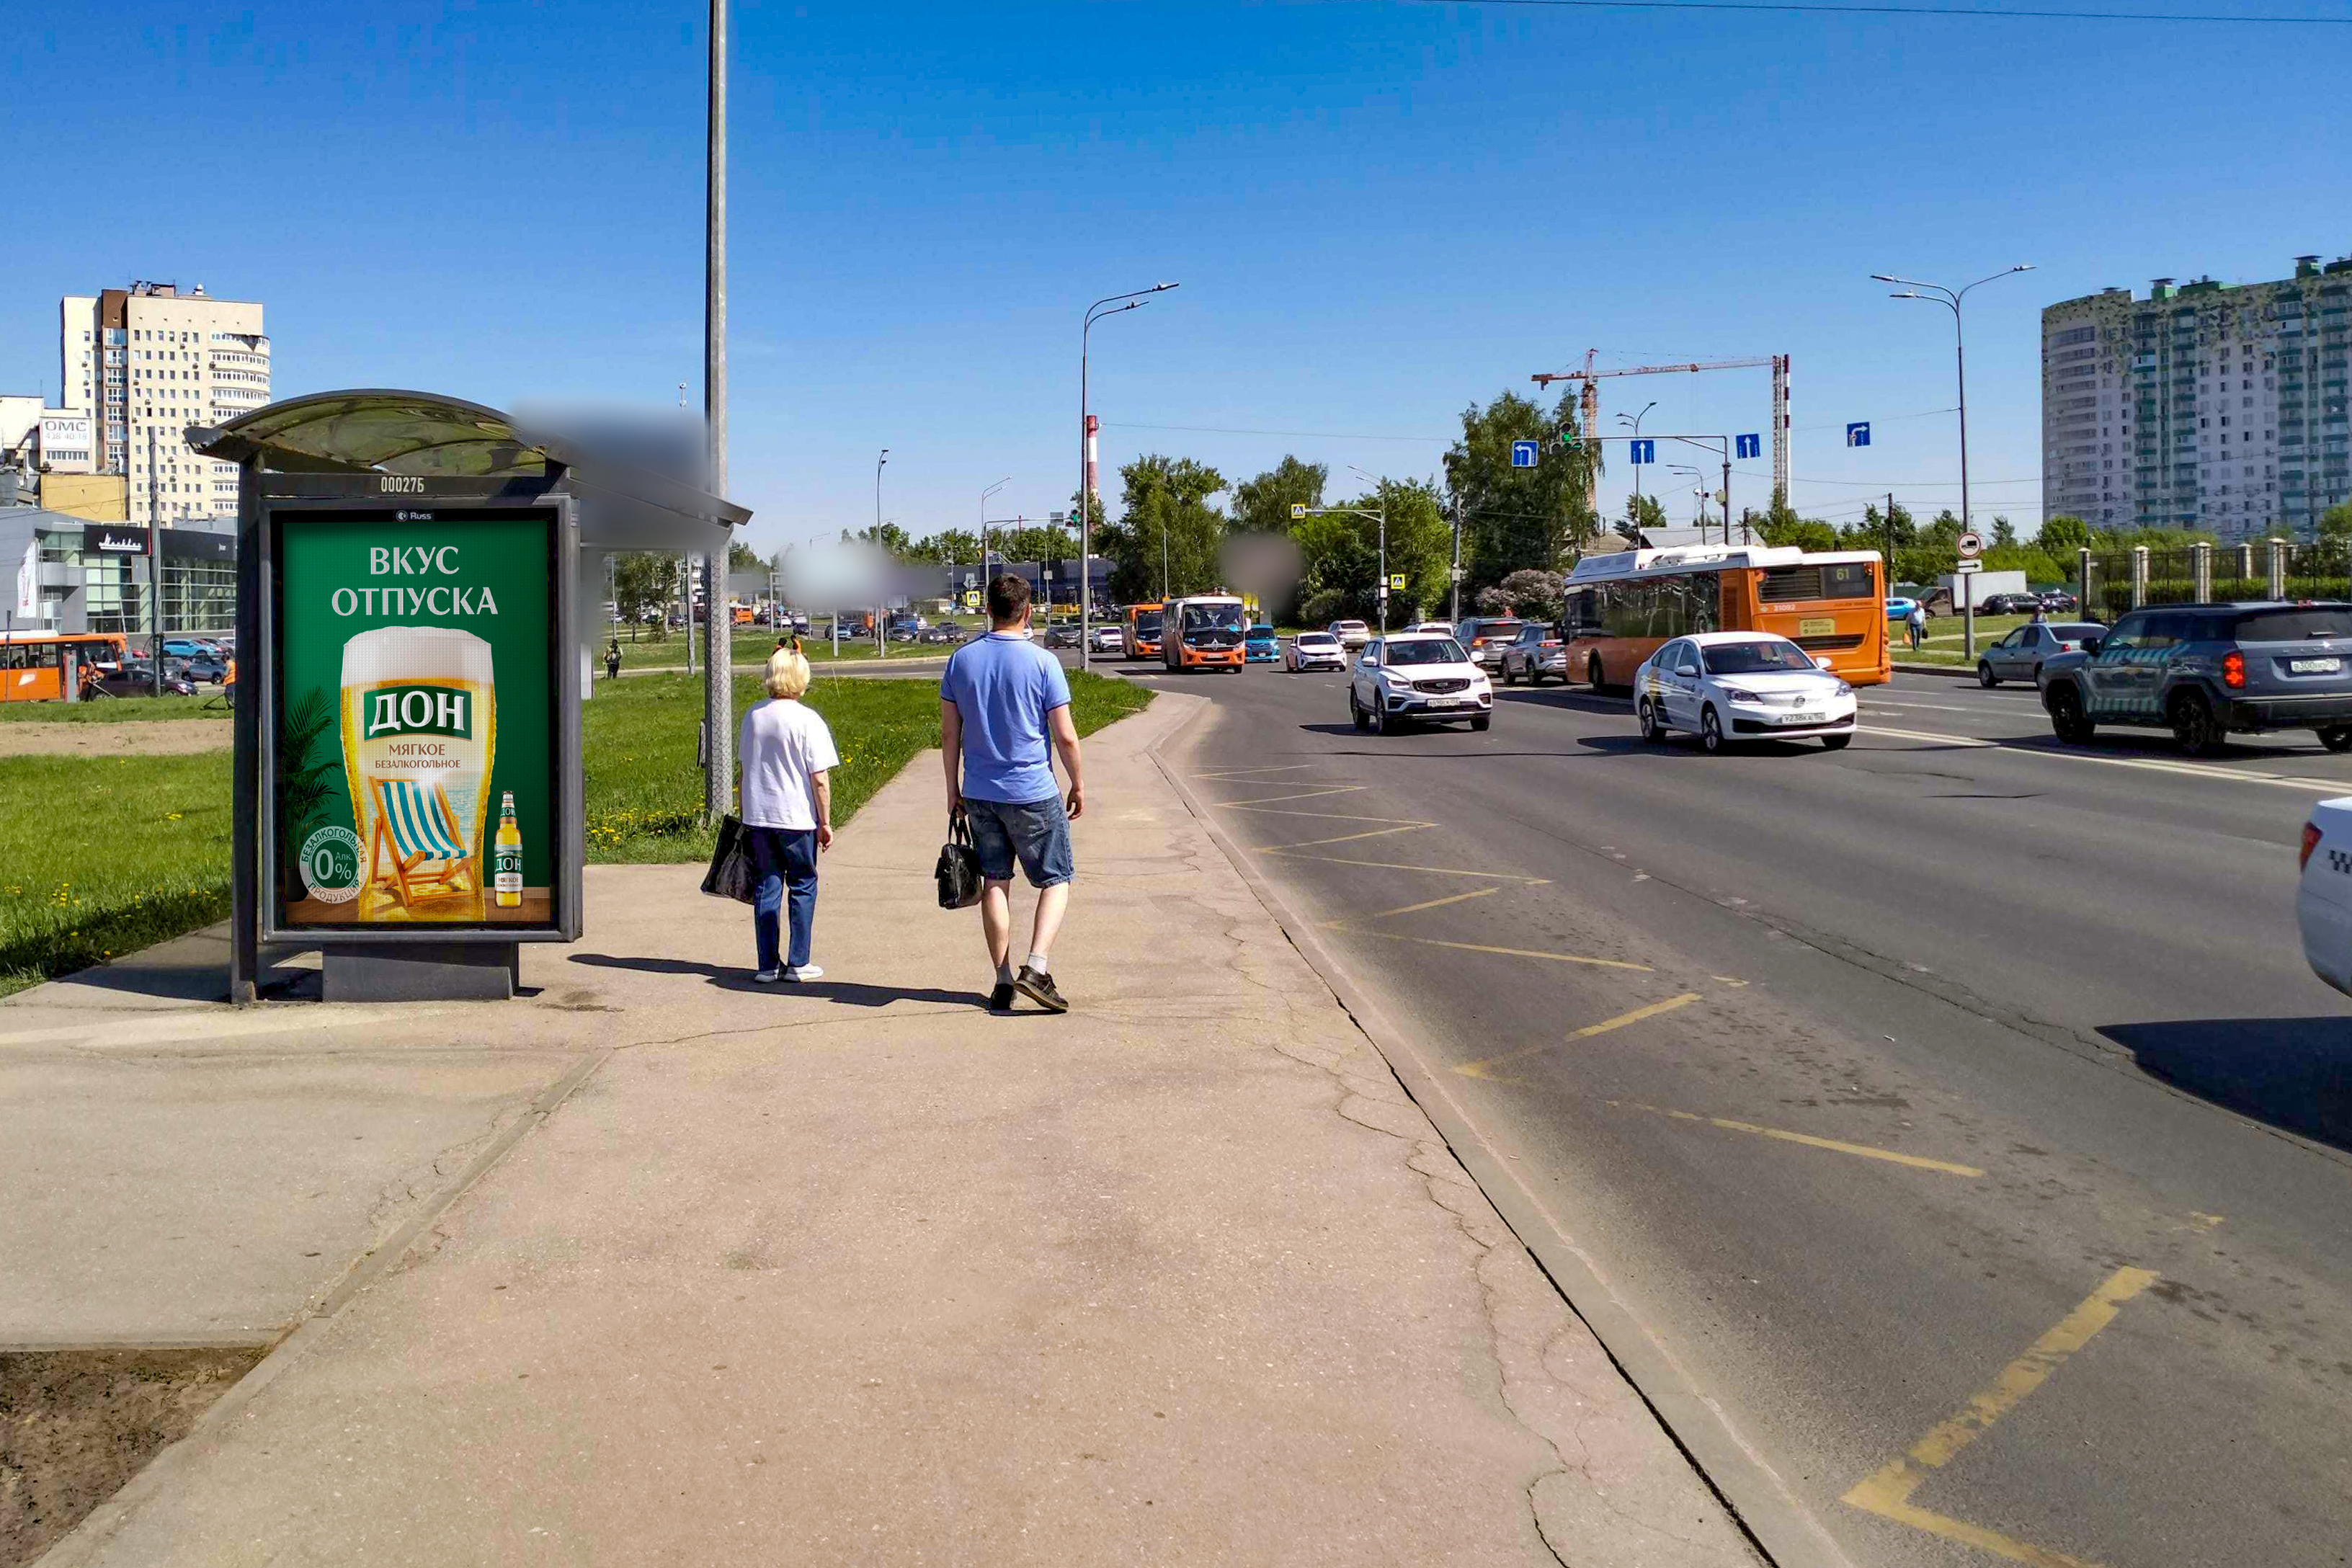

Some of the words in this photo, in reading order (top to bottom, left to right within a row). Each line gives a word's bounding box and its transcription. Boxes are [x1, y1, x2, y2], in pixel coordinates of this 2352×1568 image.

[409, 512, 432, 520] Russ
[370, 545, 460, 575] ВКУС
[1837, 568, 1850, 580] 61
[331, 587, 499, 616] ОТПУСКА
[368, 690, 466, 736] ДОН
[388, 743, 446, 757] МЯГКОЕ
[375, 760, 461, 769] БЕЗАЛКОГОЛЬНОЕ
[495, 858, 521, 871] ДОН
